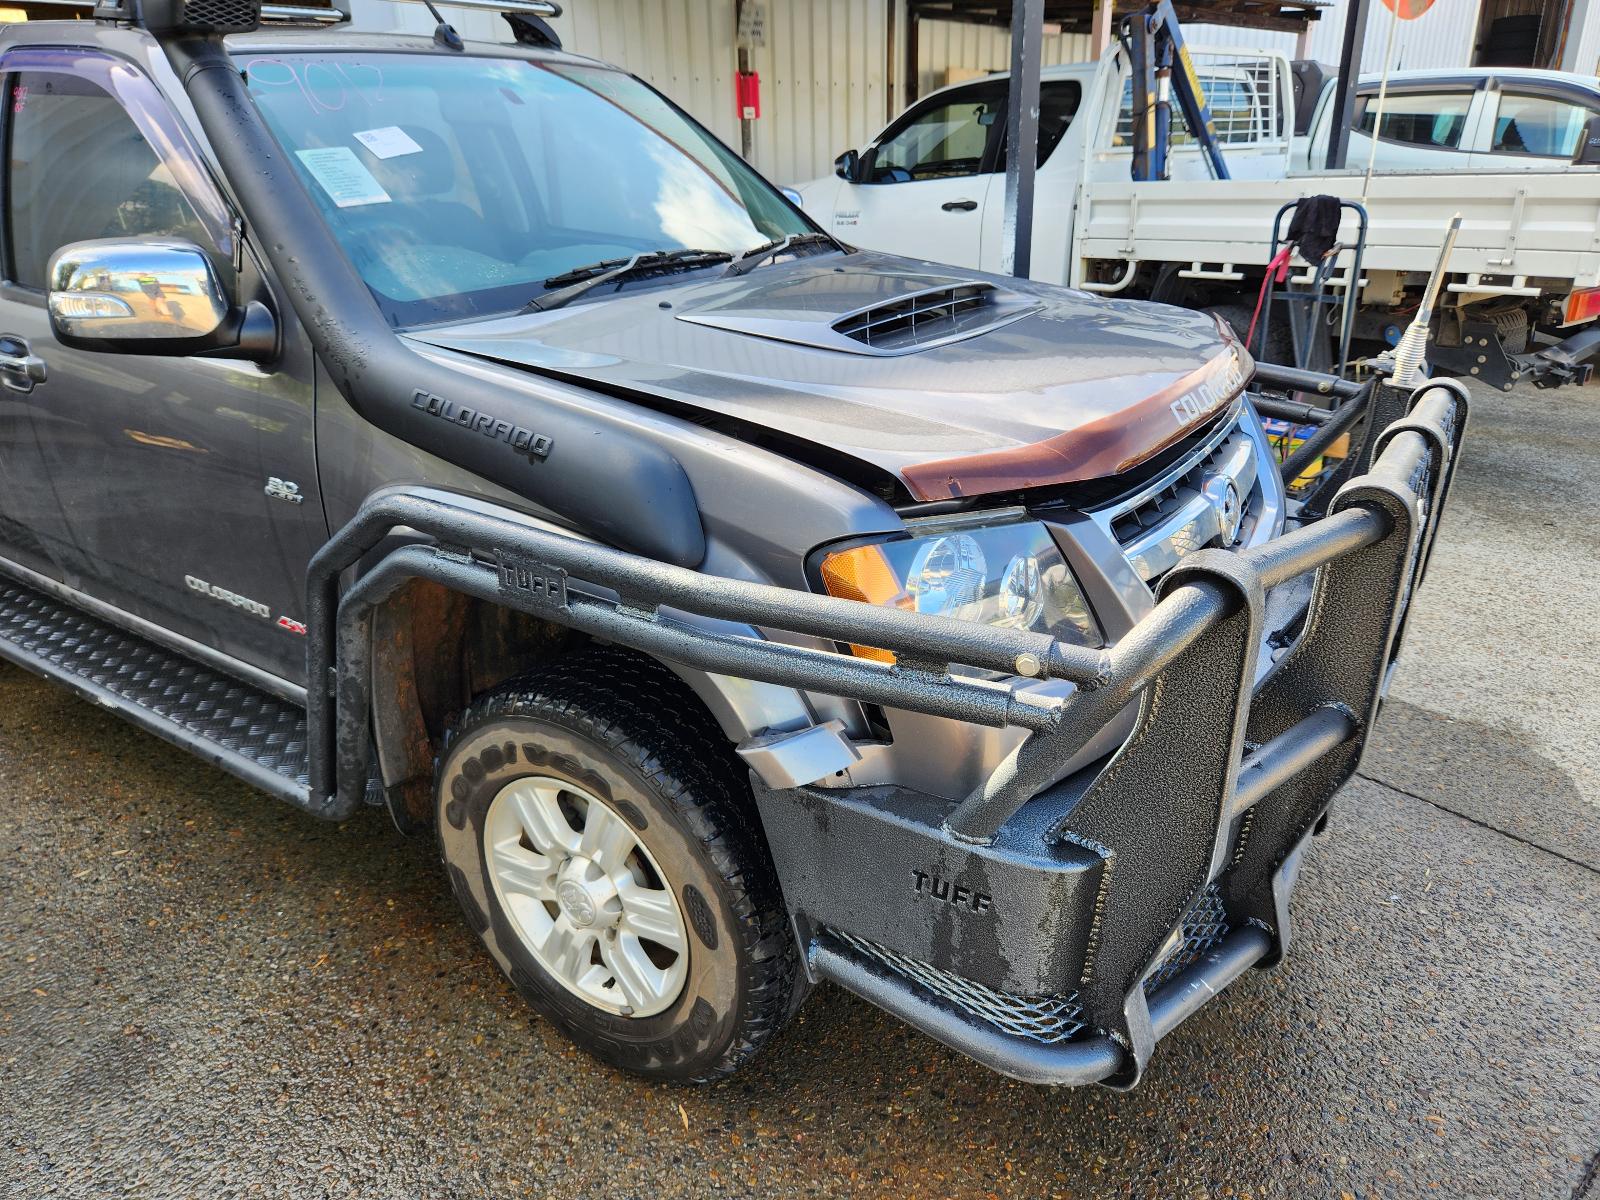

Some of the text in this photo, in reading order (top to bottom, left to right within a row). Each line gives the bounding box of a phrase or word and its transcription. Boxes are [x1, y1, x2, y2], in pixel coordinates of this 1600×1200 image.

[410, 387, 554, 458] COLORADO
[501, 563, 560, 599] TUFF
[911, 869, 993, 914] TUFF
